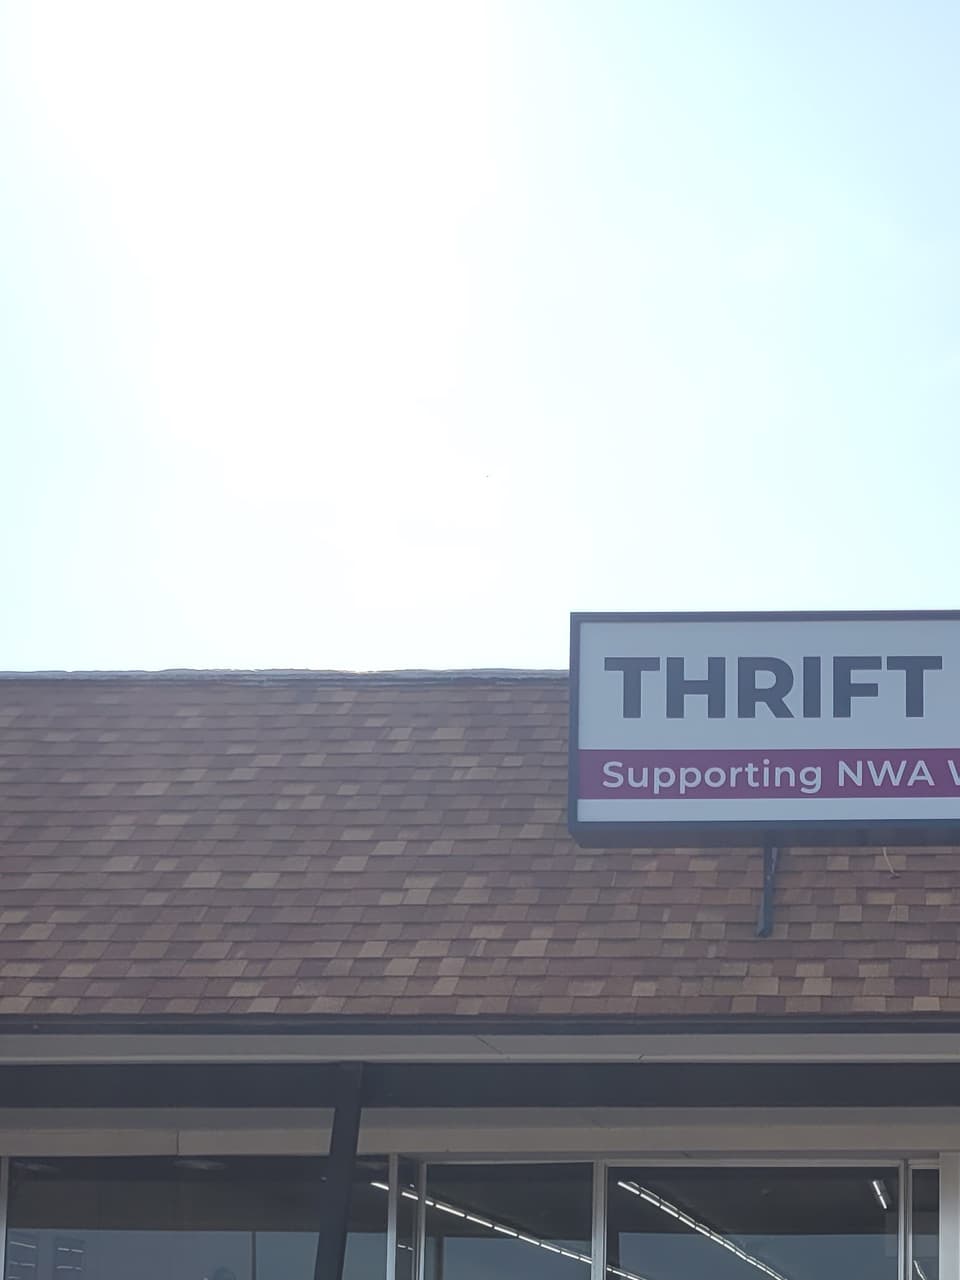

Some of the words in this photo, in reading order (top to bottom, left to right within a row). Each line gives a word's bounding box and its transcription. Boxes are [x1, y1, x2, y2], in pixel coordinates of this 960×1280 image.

[603, 655, 943, 719] THRIFT
[602, 759, 823, 794] Supporting
[837, 760, 936, 786] NWA
